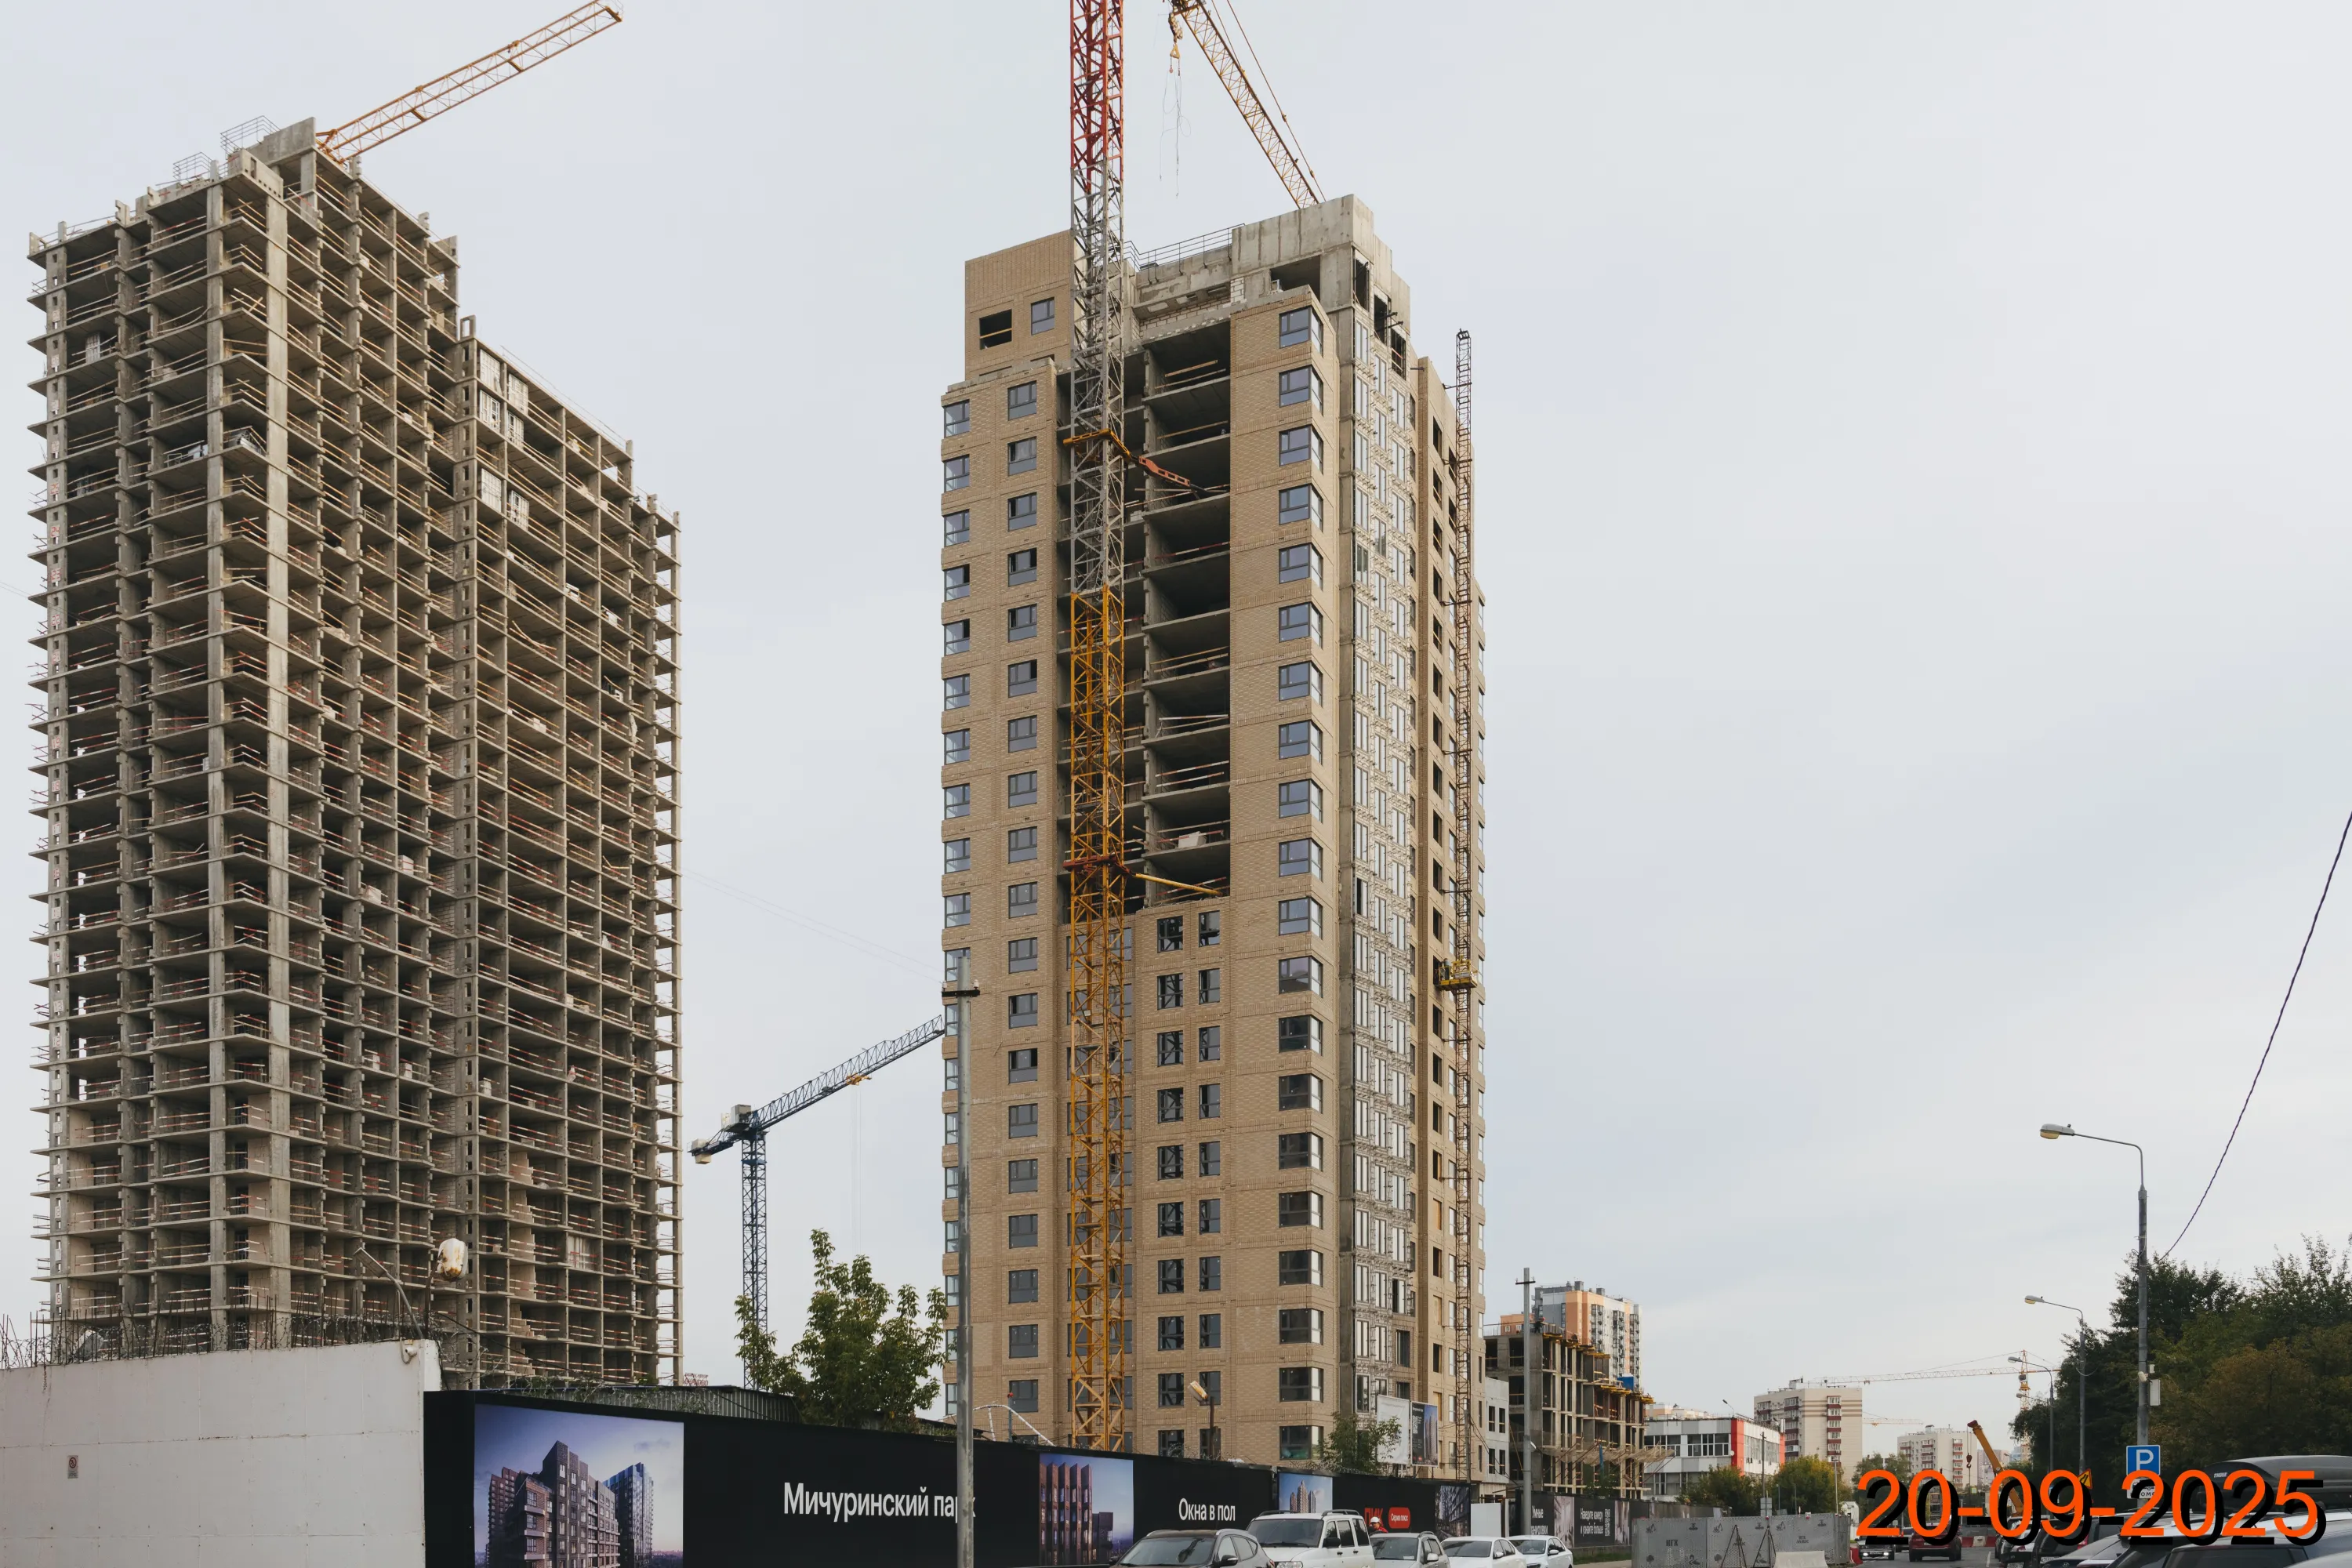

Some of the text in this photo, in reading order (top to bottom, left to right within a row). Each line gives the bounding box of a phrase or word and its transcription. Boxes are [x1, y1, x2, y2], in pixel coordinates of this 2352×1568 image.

[784, 1483, 929, 1523] Мичуринский
[1178, 1497, 1236, 1521] Окна в пол
